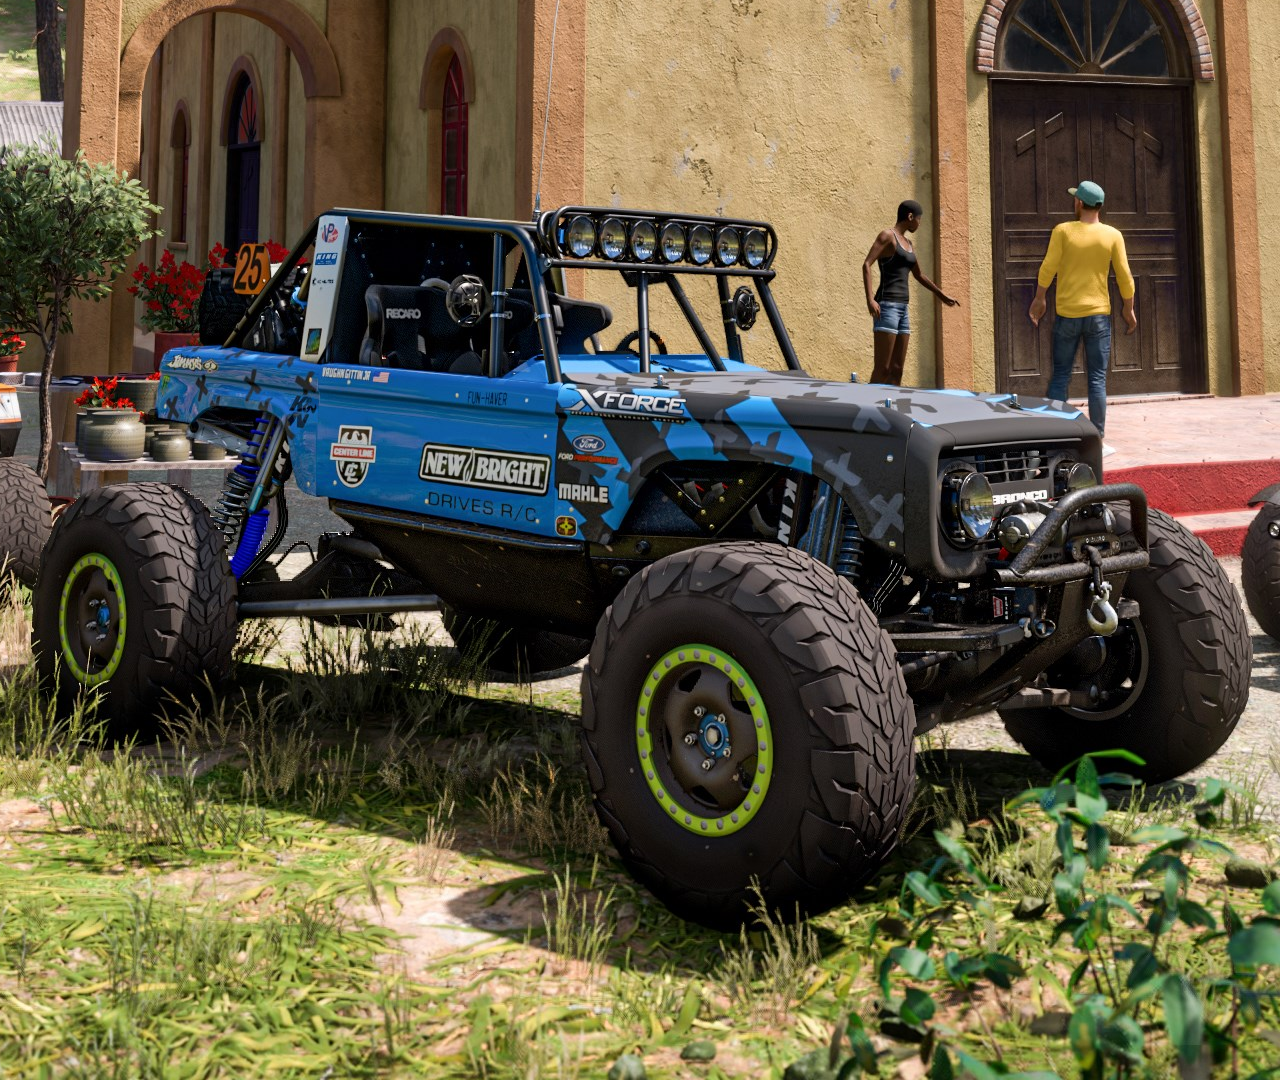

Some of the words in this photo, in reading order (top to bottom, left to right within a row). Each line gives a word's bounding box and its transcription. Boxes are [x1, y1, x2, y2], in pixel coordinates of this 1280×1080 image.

[316, 253, 337, 261] KING
[234, 245, 265, 290] 25
[385, 308, 421, 319] RECARO
[322, 367, 346, 379] VAUGHN
[345, 369, 363, 380] GITTIN
[467, 391, 508, 406] FUN-HAVER
[563, 388, 687, 416] XFORCE
[579, 438, 599, 449] Ford
[333, 448, 358, 457] CENTER
[358, 449, 373, 458] LINE
[557, 452, 574, 461] FORD
[425, 451, 467, 477] NEW
[474, 456, 545, 487] BRIGHT
[558, 483, 609, 504] MAHLE
[992, 490, 1048, 505] BRONCO
[428, 491, 494, 516] DRIVES
[501, 503, 537, 522] R/C
